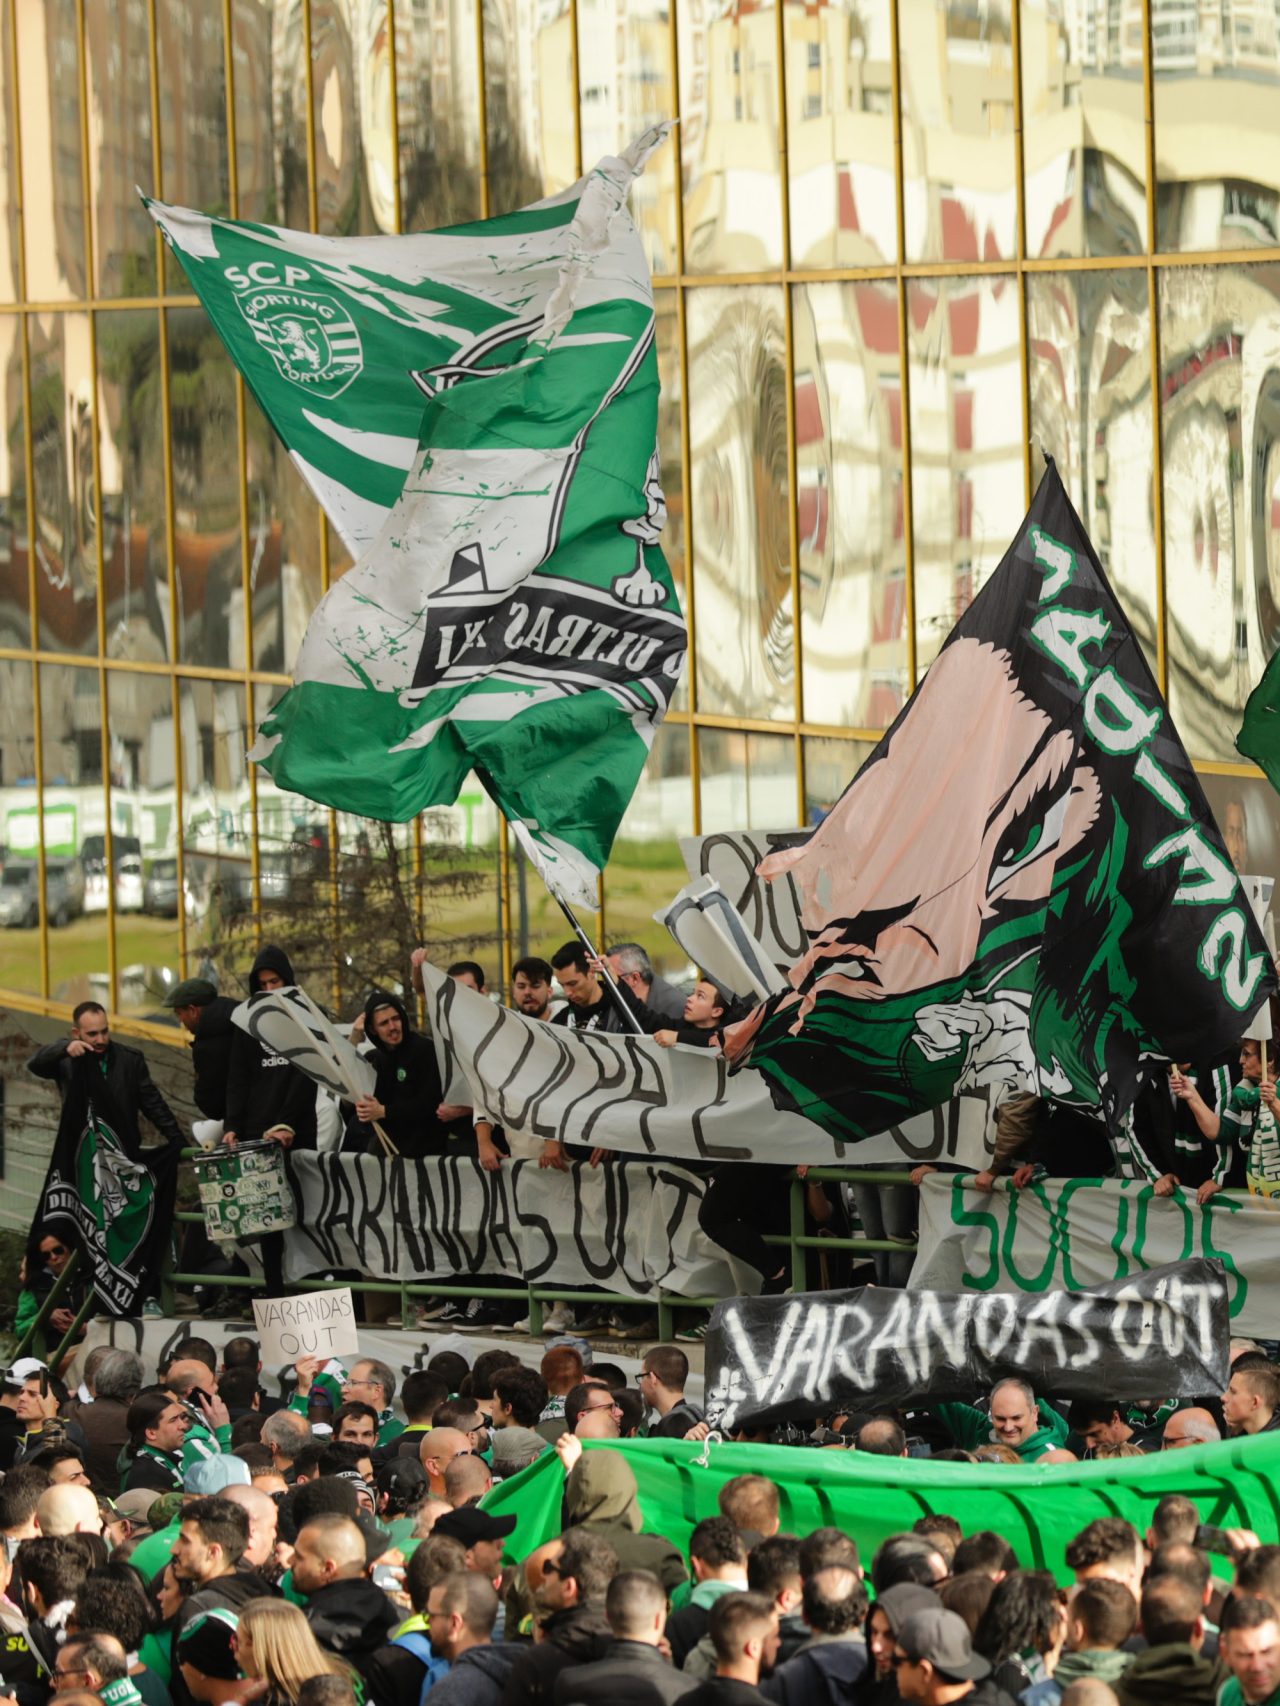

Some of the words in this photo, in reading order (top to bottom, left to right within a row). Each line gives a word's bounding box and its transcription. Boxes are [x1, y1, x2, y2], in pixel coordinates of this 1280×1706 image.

[224, 261, 311, 289] SCP
[246, 294, 336, 319] SORTING
[283, 1151, 559, 1281] VARANDAS
[256, 1295, 352, 1328] VARANDAS
[1109, 1272, 1226, 1361] OUT
[280, 1326, 337, 1355] OUT
